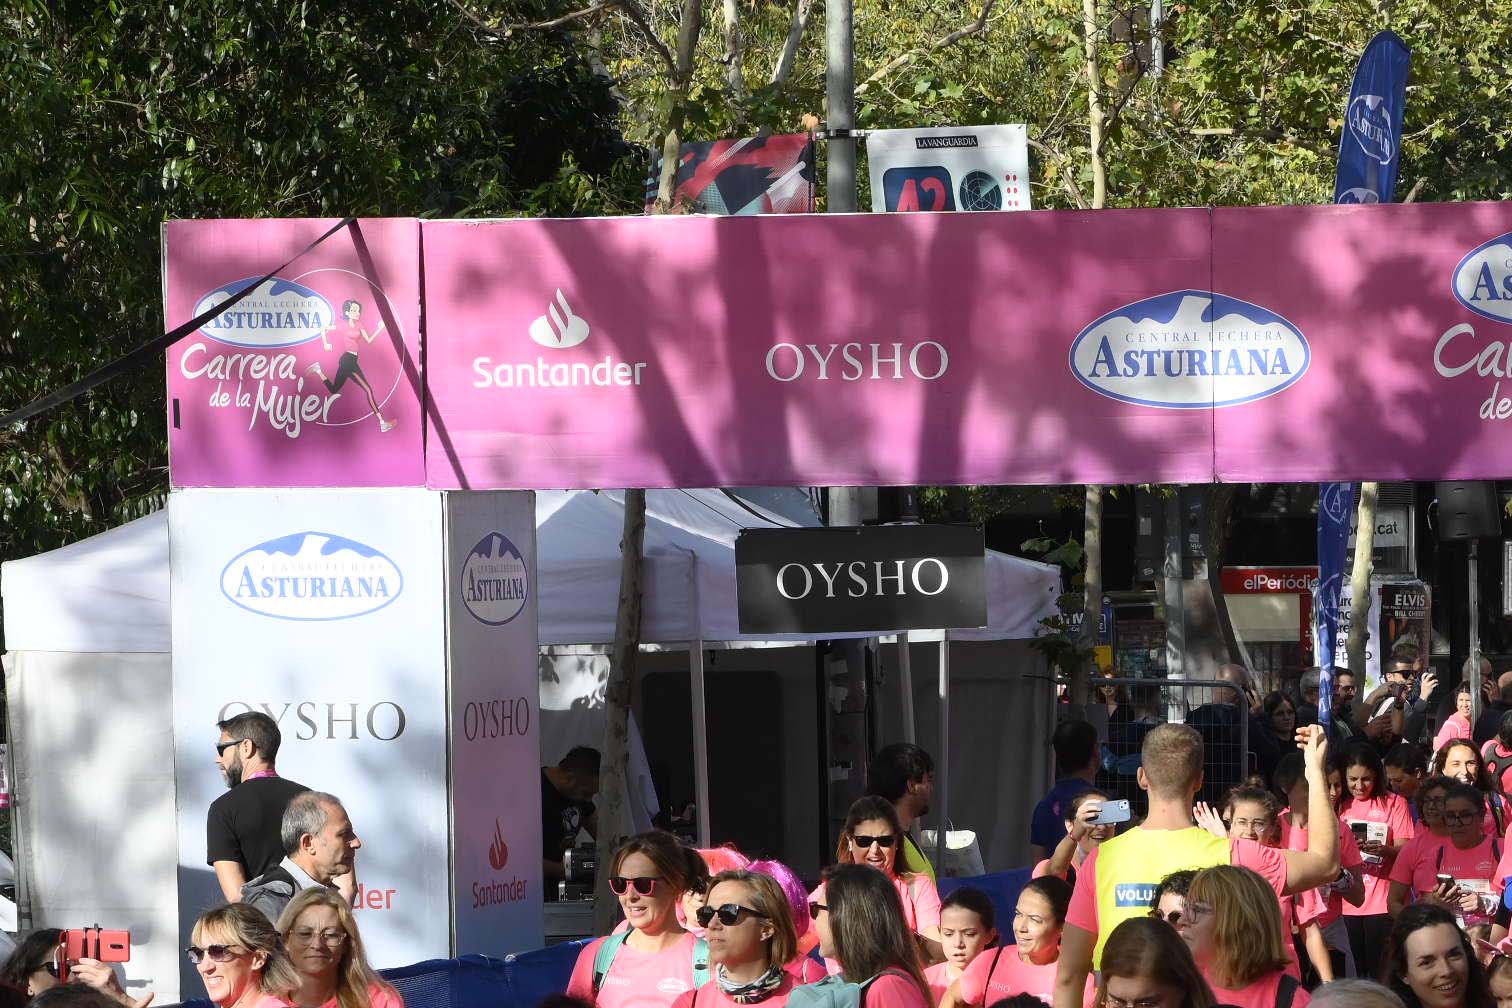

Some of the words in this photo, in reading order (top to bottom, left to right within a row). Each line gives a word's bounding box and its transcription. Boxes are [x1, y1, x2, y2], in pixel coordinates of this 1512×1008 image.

[1125, 331, 1199, 344] CENTRAL
[1206, 328, 1284, 343] LECHERA
[181, 343, 298, 380] Carrera
[472, 355, 647, 389] Santander
[764, 341, 949, 382] OYSHO
[1088, 334, 1292, 379] ASTURIANA
[209, 382, 232, 408] de
[235, 382, 251, 408] la
[249, 376, 342, 439] Mujer
[235, 564, 390, 599] ASTURIANA
[467, 567, 525, 602] ASTURIANA
[775, 558, 950, 601] OYSHO
[1395, 593, 1425, 607] ELVIS
[464, 697, 530, 742] OYSHO
[473, 877, 528, 909] Santander
